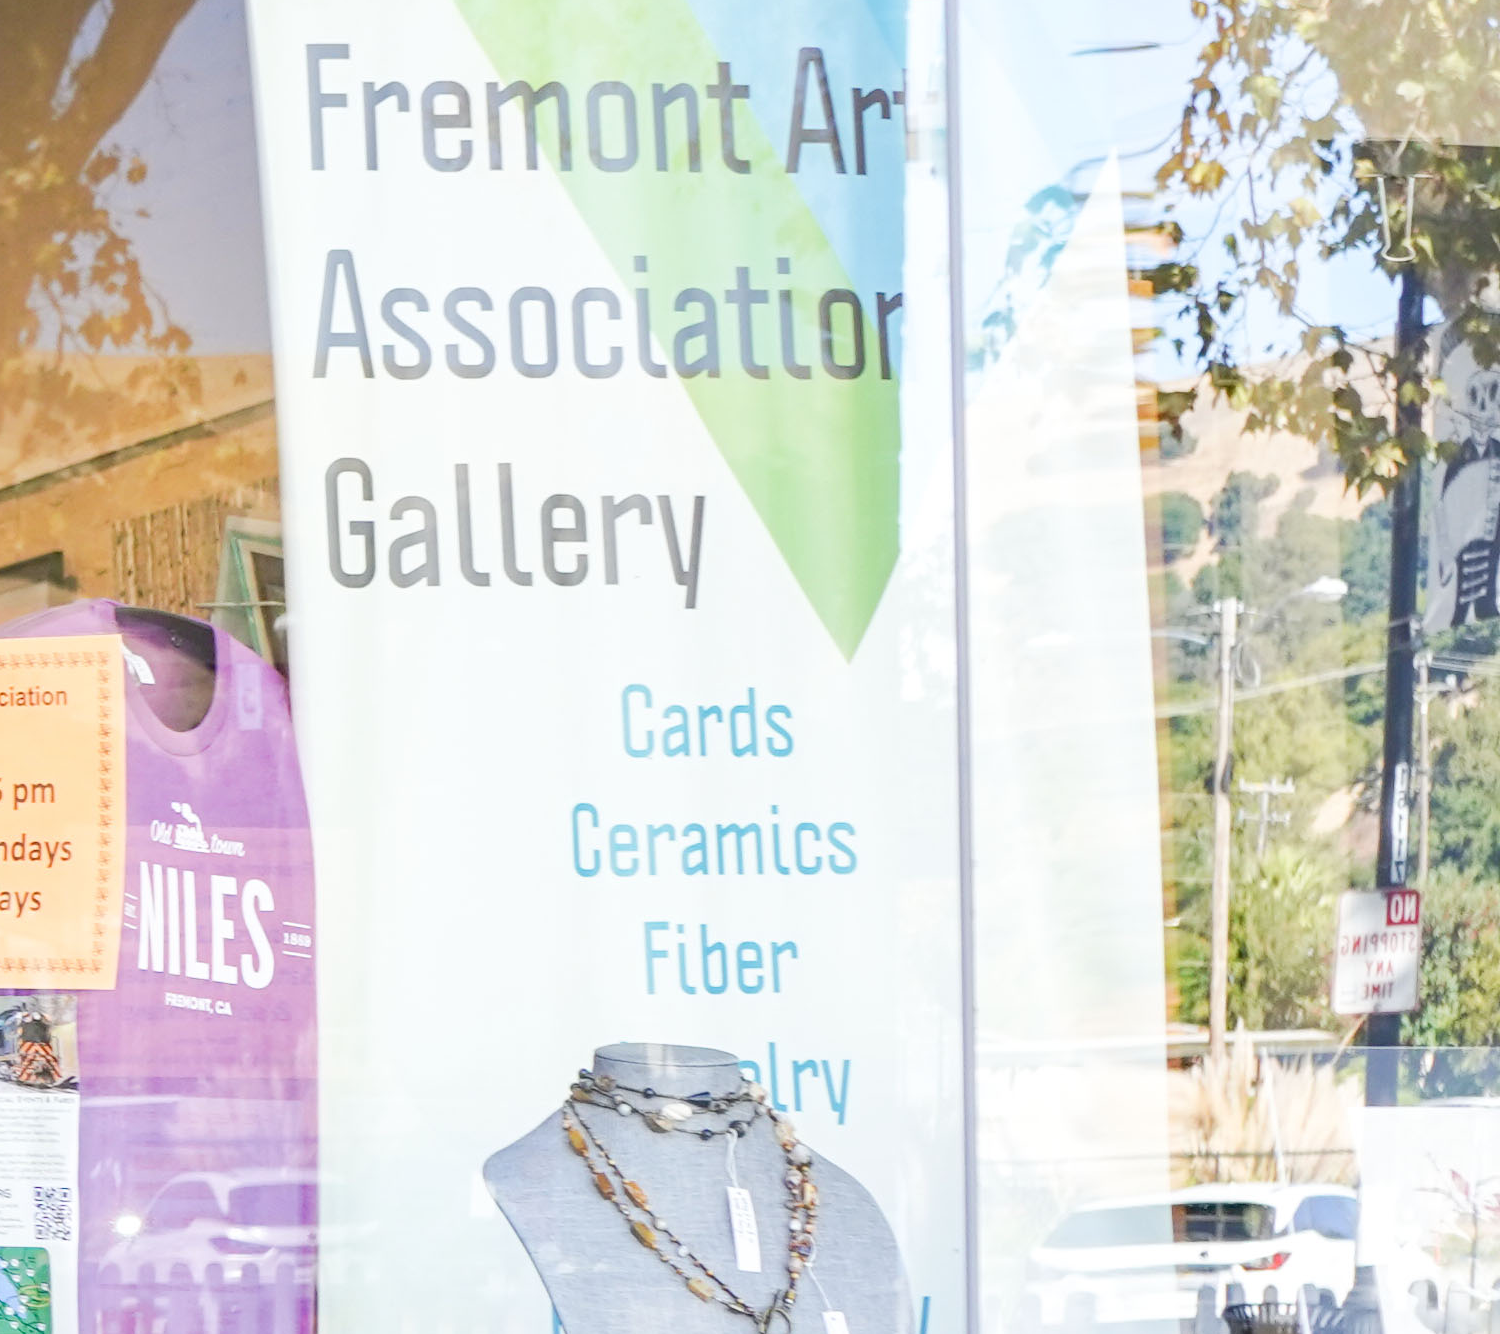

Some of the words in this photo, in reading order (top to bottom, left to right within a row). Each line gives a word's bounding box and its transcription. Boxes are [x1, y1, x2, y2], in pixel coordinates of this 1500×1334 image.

[303, 42, 752, 175] Fremont
[323, 457, 706, 609] Gallery
[621, 683, 794, 758] Cards
[13, 782, 56, 810] pm
[209, 833, 246, 857] town
[571, 802, 859, 879] Ceramics
[137, 860, 275, 989] NILES
[643, 921, 800, 996] Fiber
